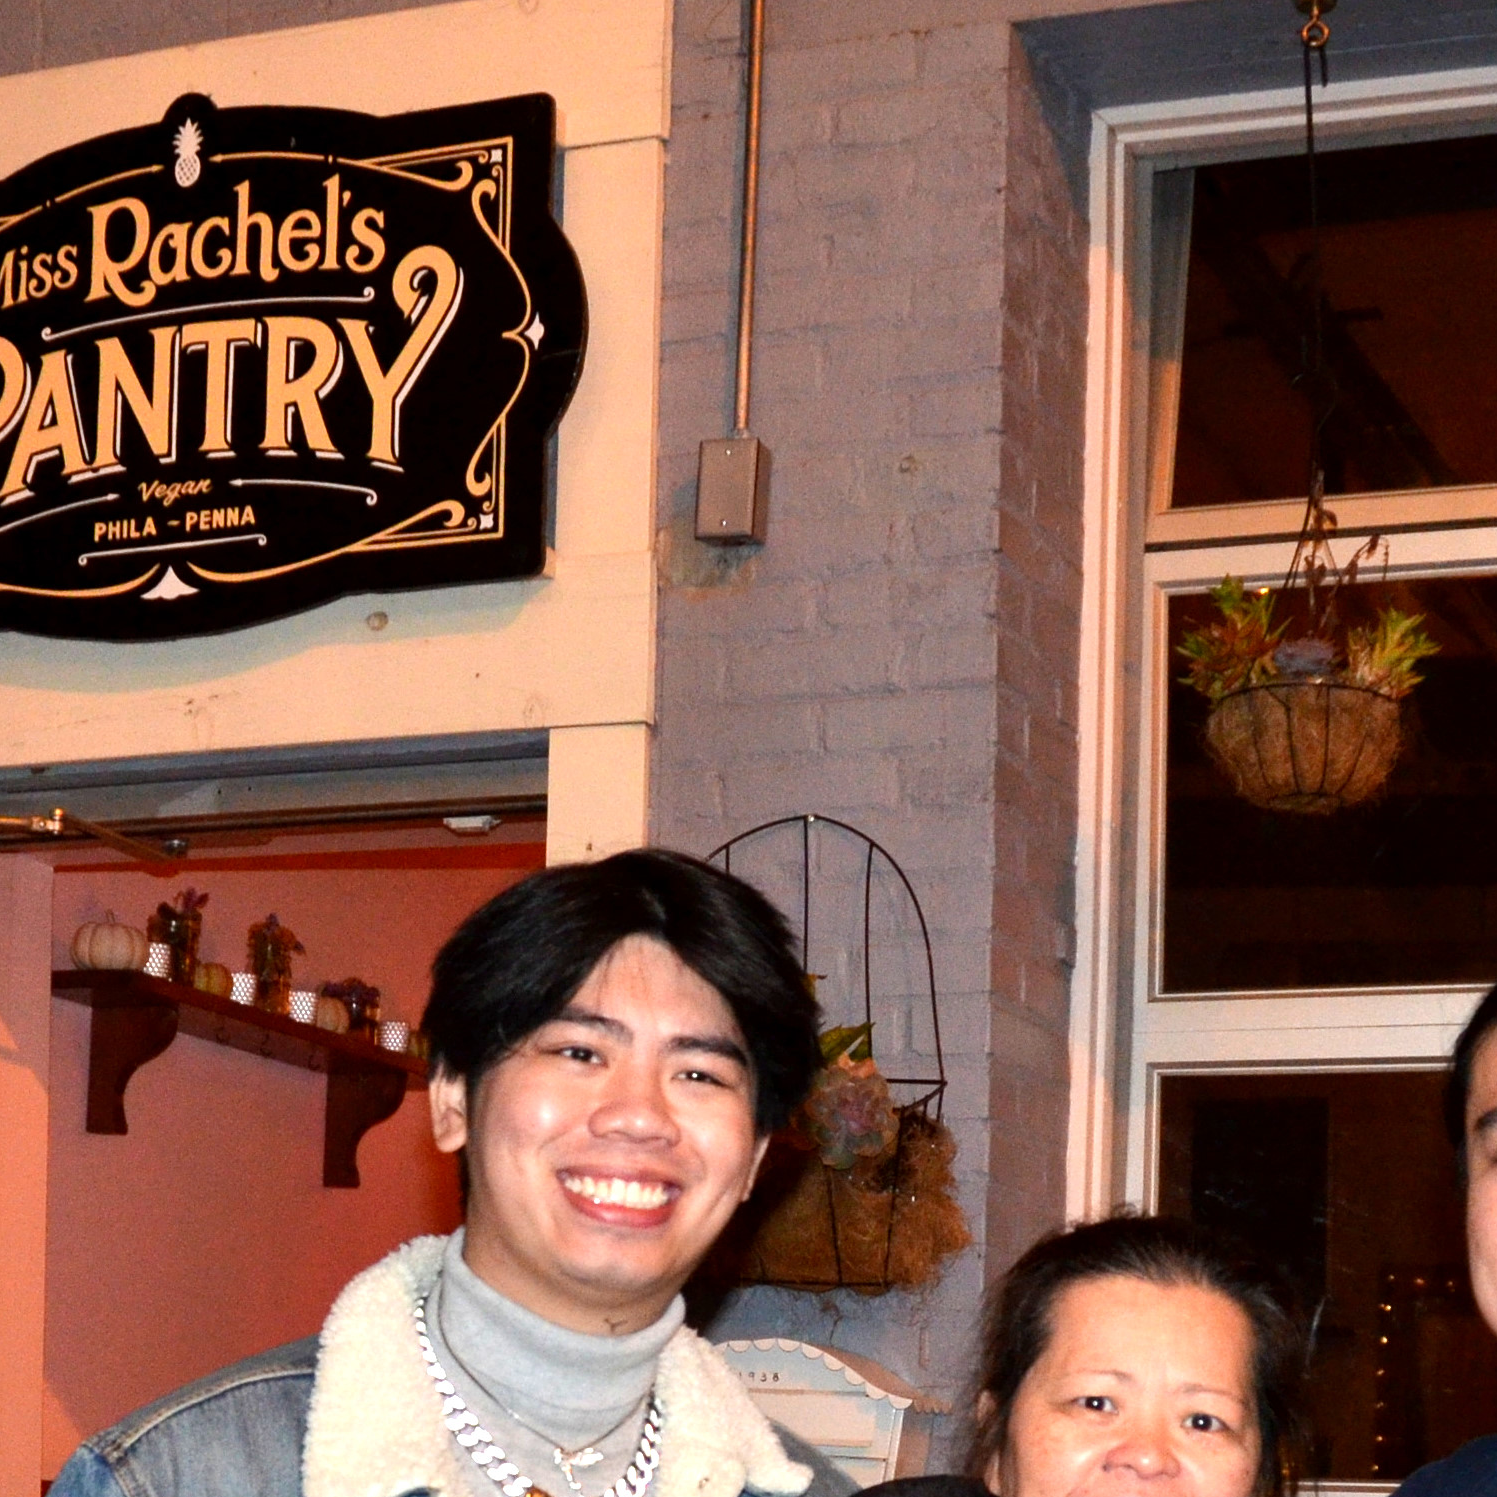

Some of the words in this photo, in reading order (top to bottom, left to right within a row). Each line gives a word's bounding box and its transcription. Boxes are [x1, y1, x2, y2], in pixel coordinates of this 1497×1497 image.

[85, 174, 386, 306] Rachel's
[137, 478, 214, 507] Vegan
[94, 516, 157, 542] PHILA
[185, 504, 256, 532] PENNA
